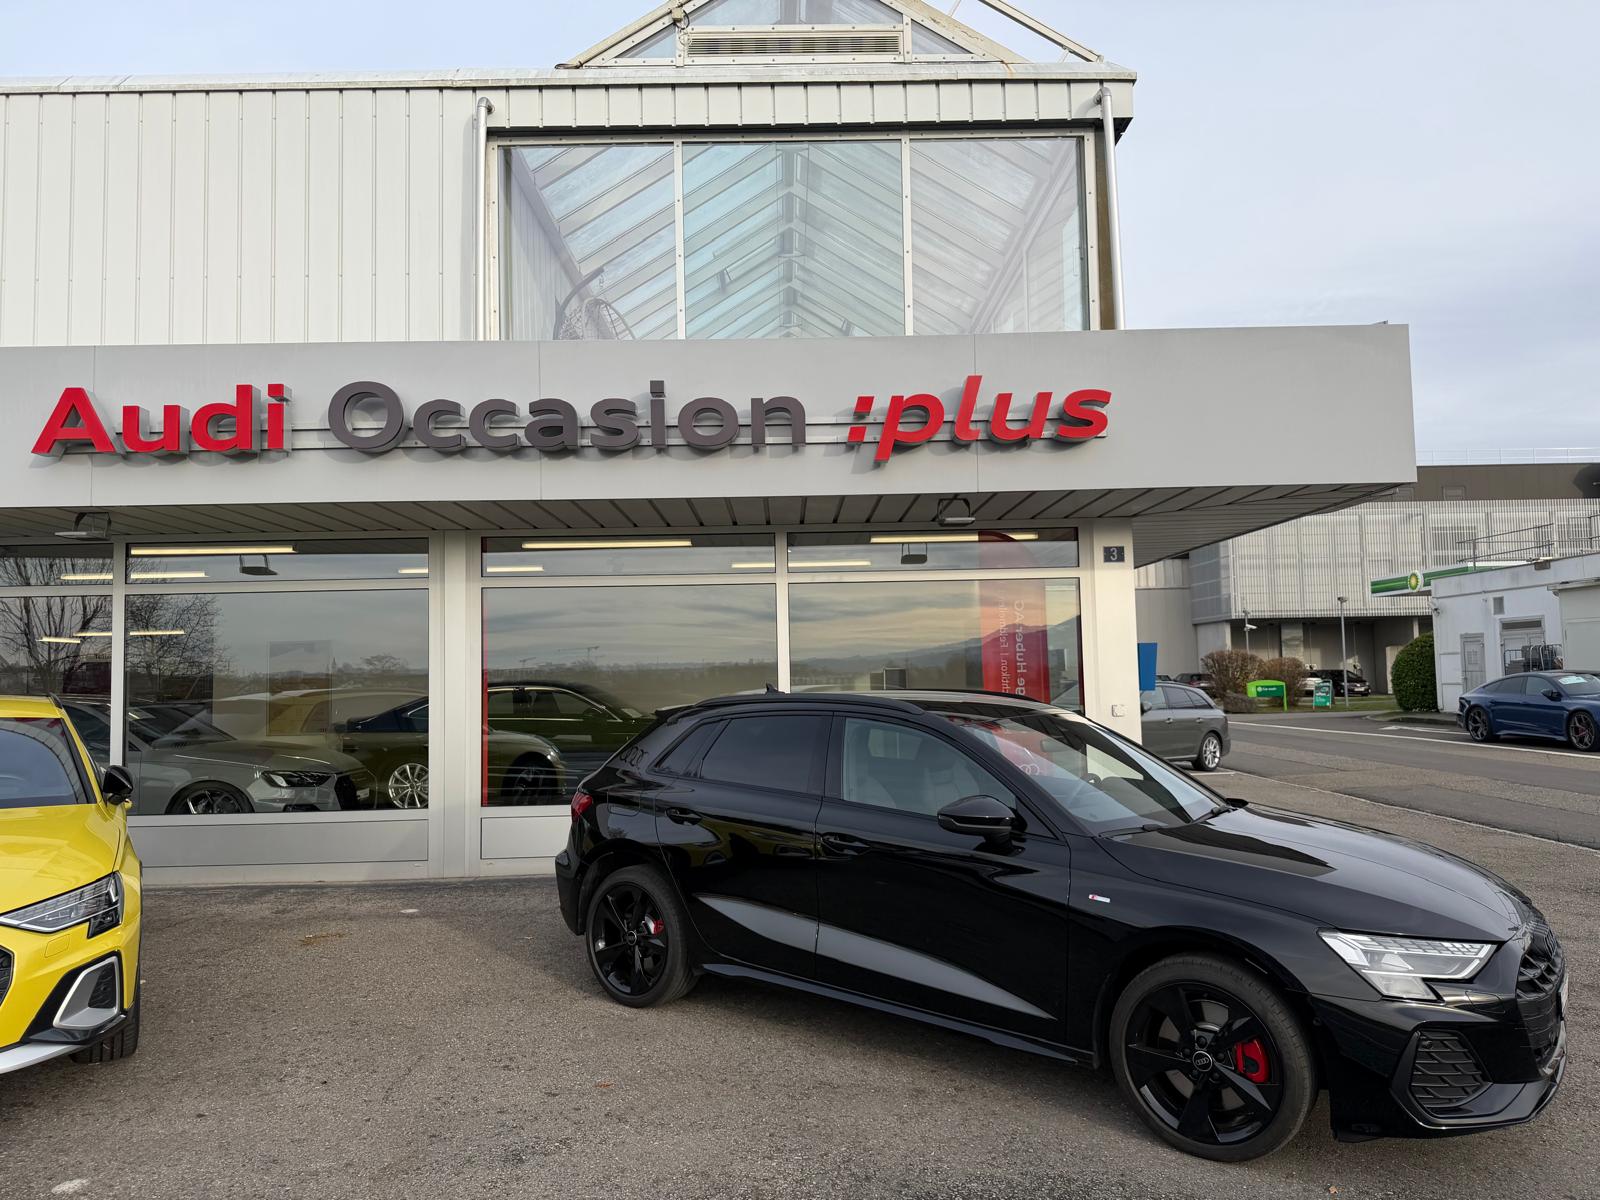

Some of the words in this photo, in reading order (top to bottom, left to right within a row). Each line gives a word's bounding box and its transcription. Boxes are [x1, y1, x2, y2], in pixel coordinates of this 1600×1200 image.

[31, 383, 288, 455] Audi
[327, 380, 807, 453] Occasion
[1110, 547, 1118, 561] 3
